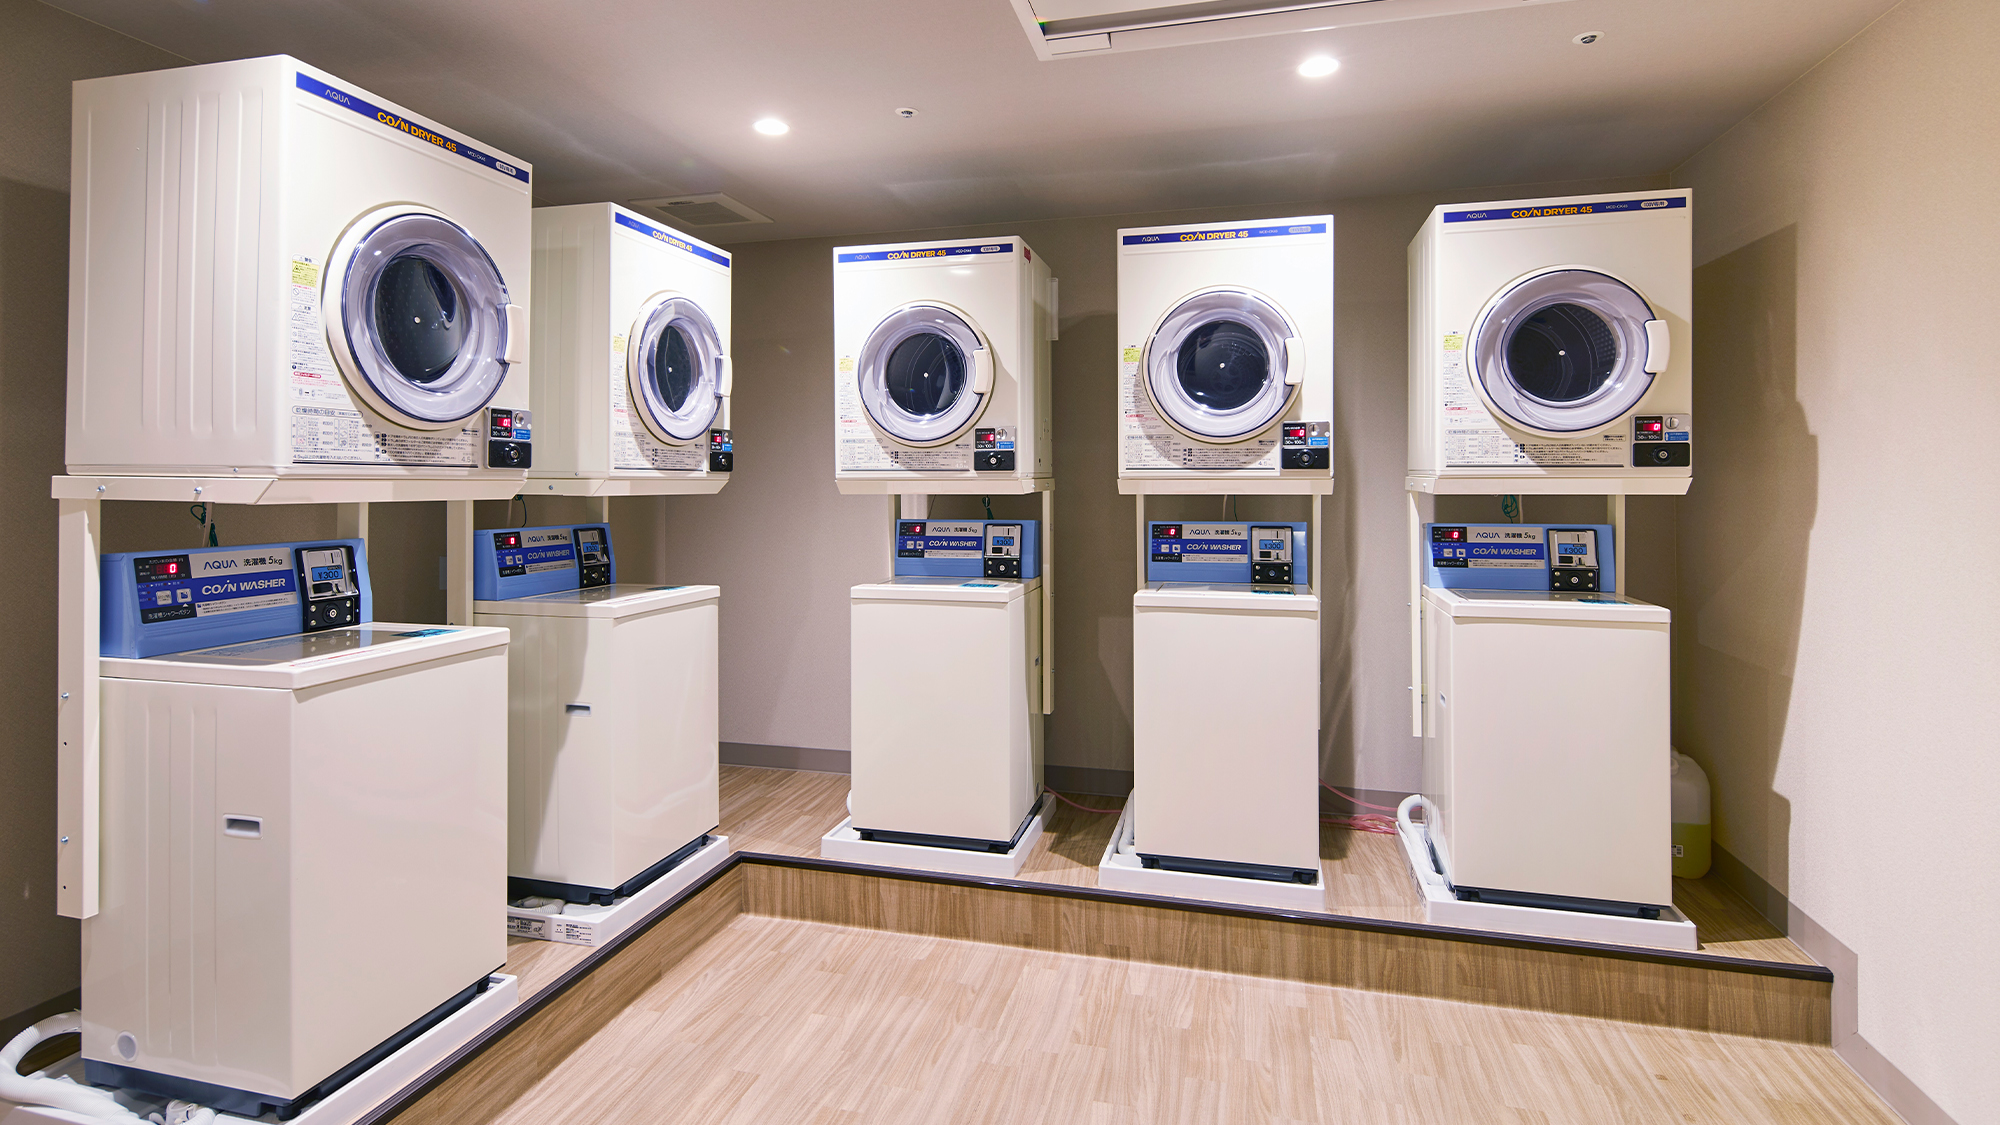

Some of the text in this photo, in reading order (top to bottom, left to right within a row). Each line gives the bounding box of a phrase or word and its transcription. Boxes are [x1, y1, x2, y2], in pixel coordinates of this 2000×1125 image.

[325, 89, 351, 106] AQUA
[411, 126, 444, 148] DRYER
[446, 141, 457, 153] 45
[1543, 206, 1578, 217] DRYER
[1580, 205, 1593, 214] 45
[1206, 231, 1236, 240] DRYER
[1237, 230, 1249, 238] 45
[669, 237, 686, 250] DRYER
[686, 244, 693, 252] 45
[910, 250, 936, 259] DRYER
[936, 249, 947, 257] 45
[527, 535, 545, 543] AQUA
[546, 549, 570, 558] WASHER
[203, 555, 283, 570] AQUA 洗濯機 5kg
[169, 563, 177, 574] 0
[318, 570, 339, 580] ¥300
[240, 578, 286, 591] WASHER
